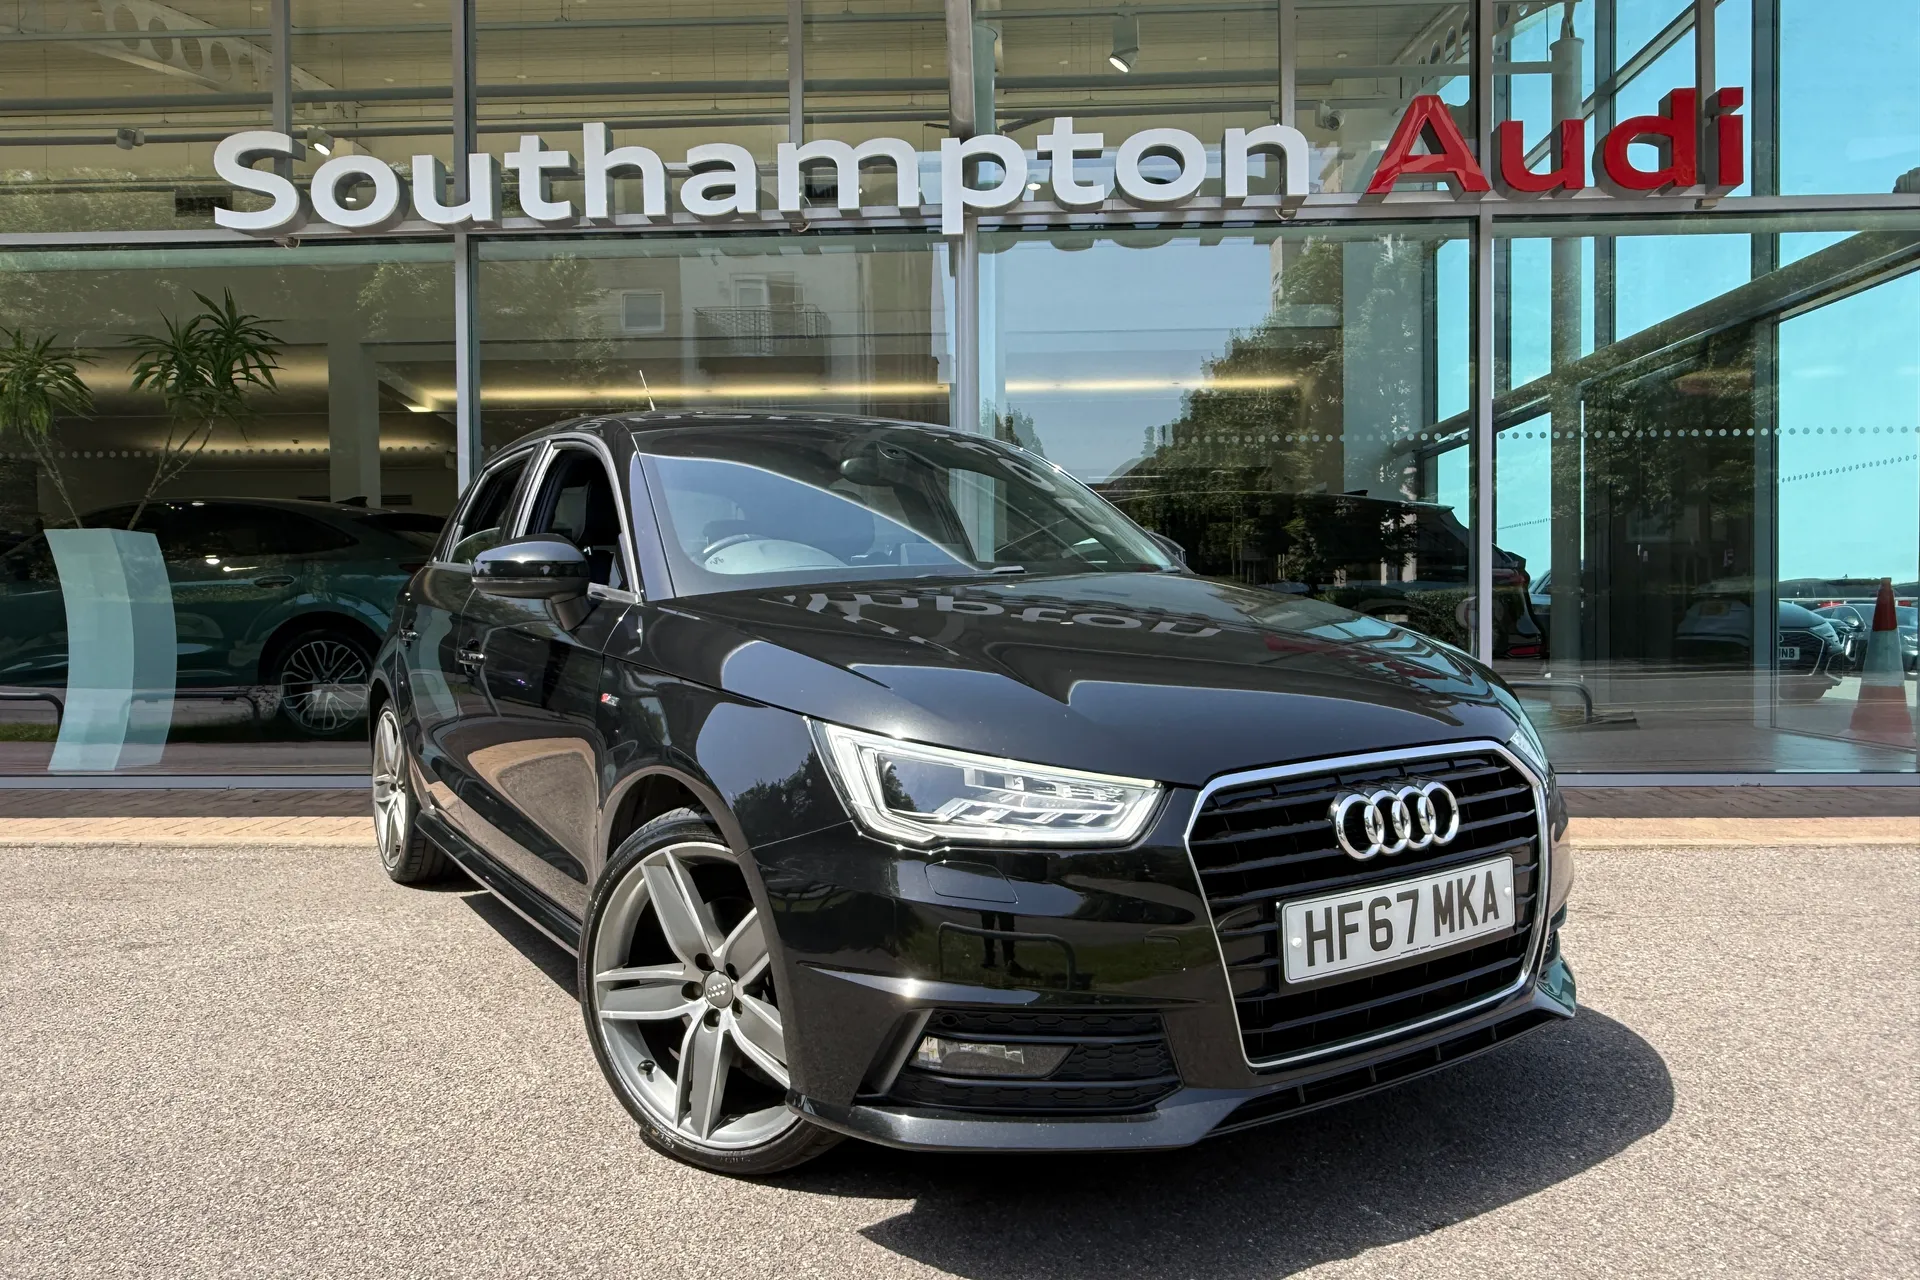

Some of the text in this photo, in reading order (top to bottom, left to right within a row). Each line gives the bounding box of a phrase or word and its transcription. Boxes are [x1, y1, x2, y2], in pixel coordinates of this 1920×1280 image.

[213, 86, 1744, 236] Southampton Audi
[1778, 647, 1795, 658] NB
[1304, 870, 1500, 967] HF67 MKA
